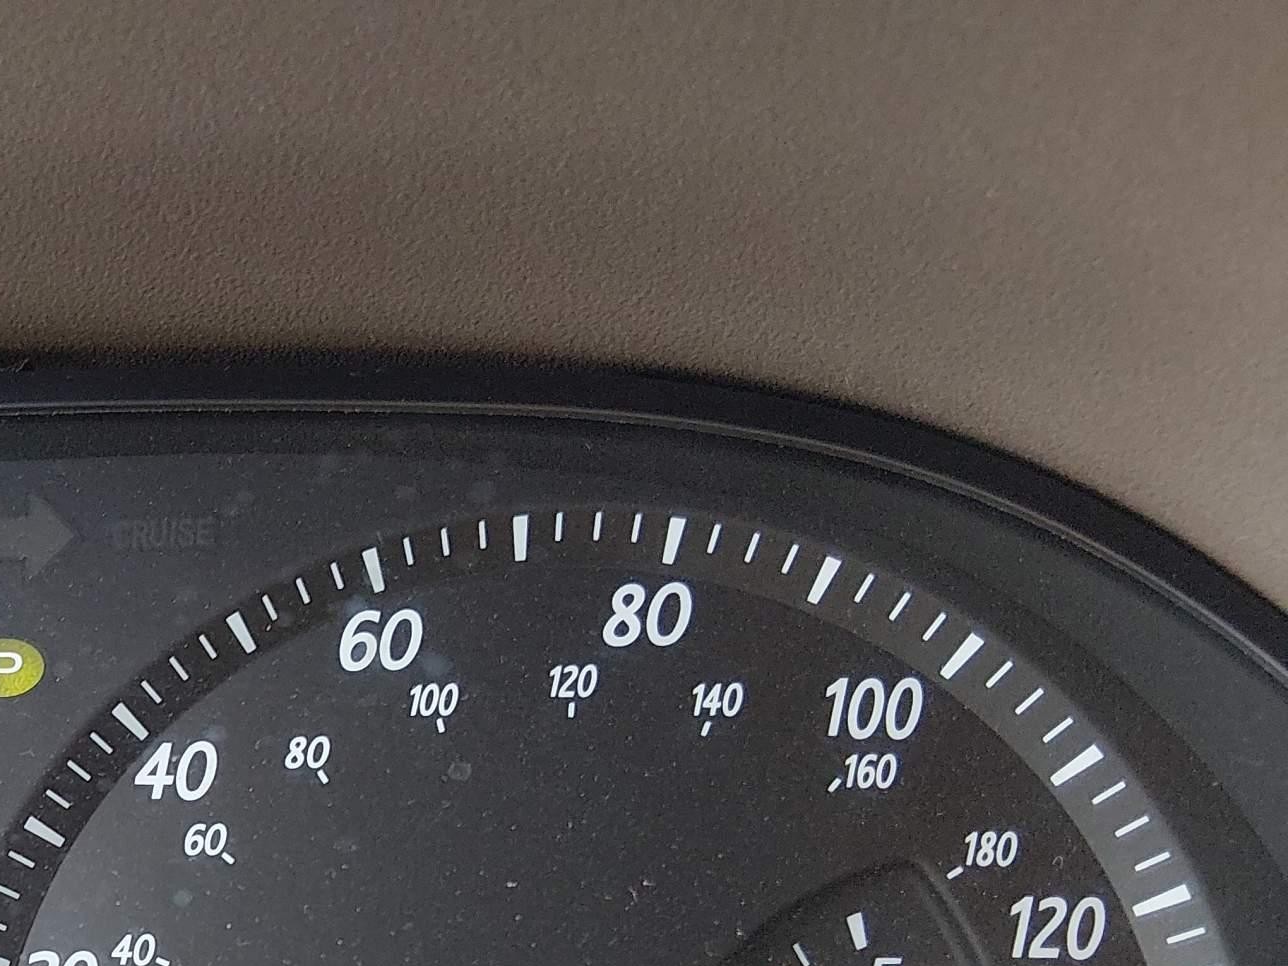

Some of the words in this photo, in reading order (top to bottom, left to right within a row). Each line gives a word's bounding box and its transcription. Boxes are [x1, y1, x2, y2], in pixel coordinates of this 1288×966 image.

[602, 581, 693, 647] 80
[339, 608, 423, 673] 60
[549, 663, 598, 699] 120
[691, 681, 744, 718] 140
[409, 682, 459, 718] 100
[825, 677, 923, 741] 100
[134, 740, 218, 802] 40
[284, 735, 331, 771] 80
[844, 753, 897, 790] 160
[184, 822, 228, 857] 60
[964, 830, 1019, 868] 180
[1010, 895, 1106, 961] 120
[111, 933, 156, 966] 40
